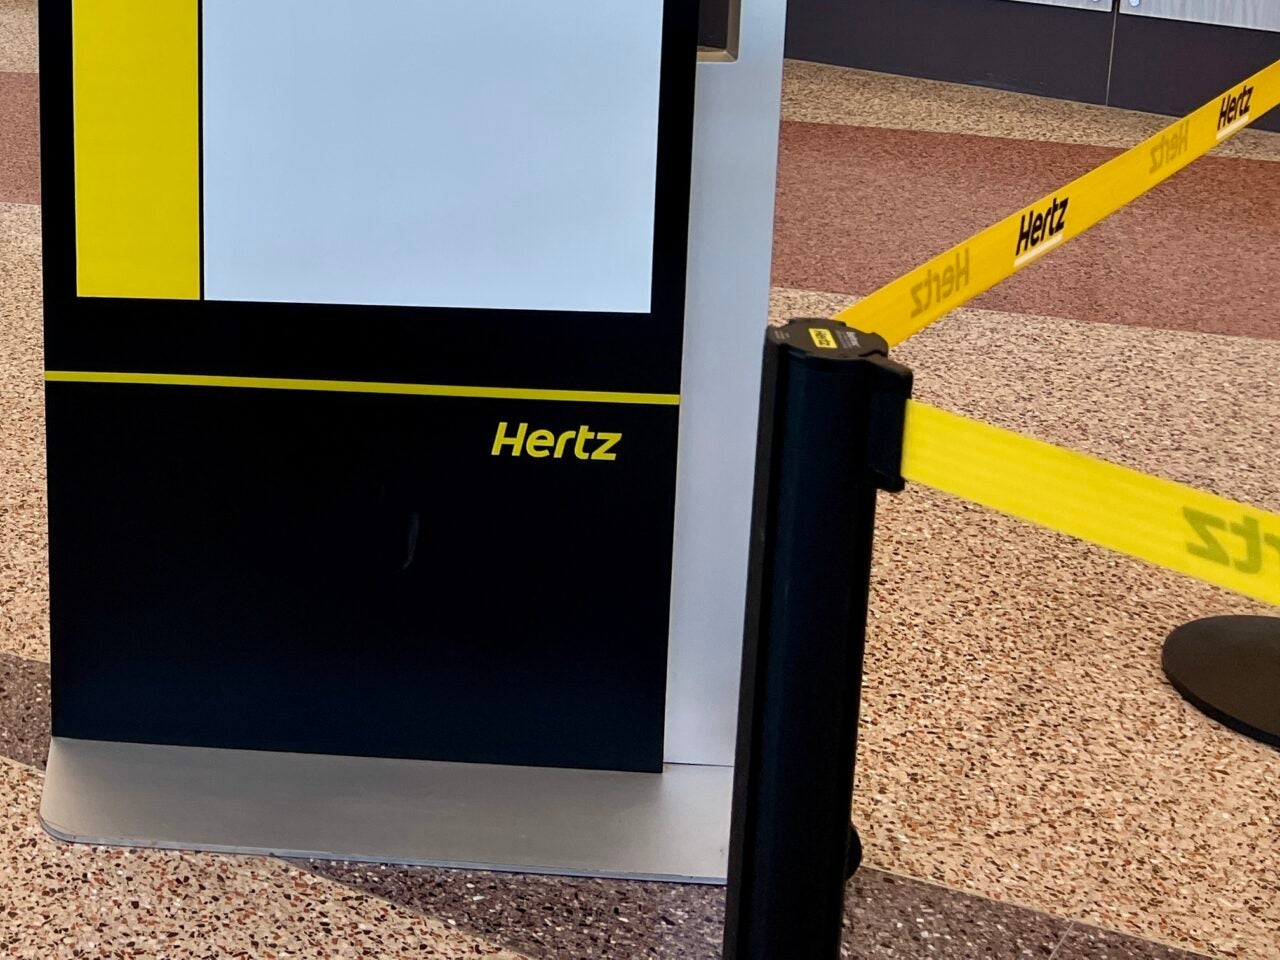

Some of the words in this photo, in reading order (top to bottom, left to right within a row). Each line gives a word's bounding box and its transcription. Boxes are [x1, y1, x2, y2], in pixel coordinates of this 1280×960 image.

[1217, 85, 1254, 132] Hertz
[1016, 196, 1069, 256] Hertz
[491, 421, 623, 461] Hertz
